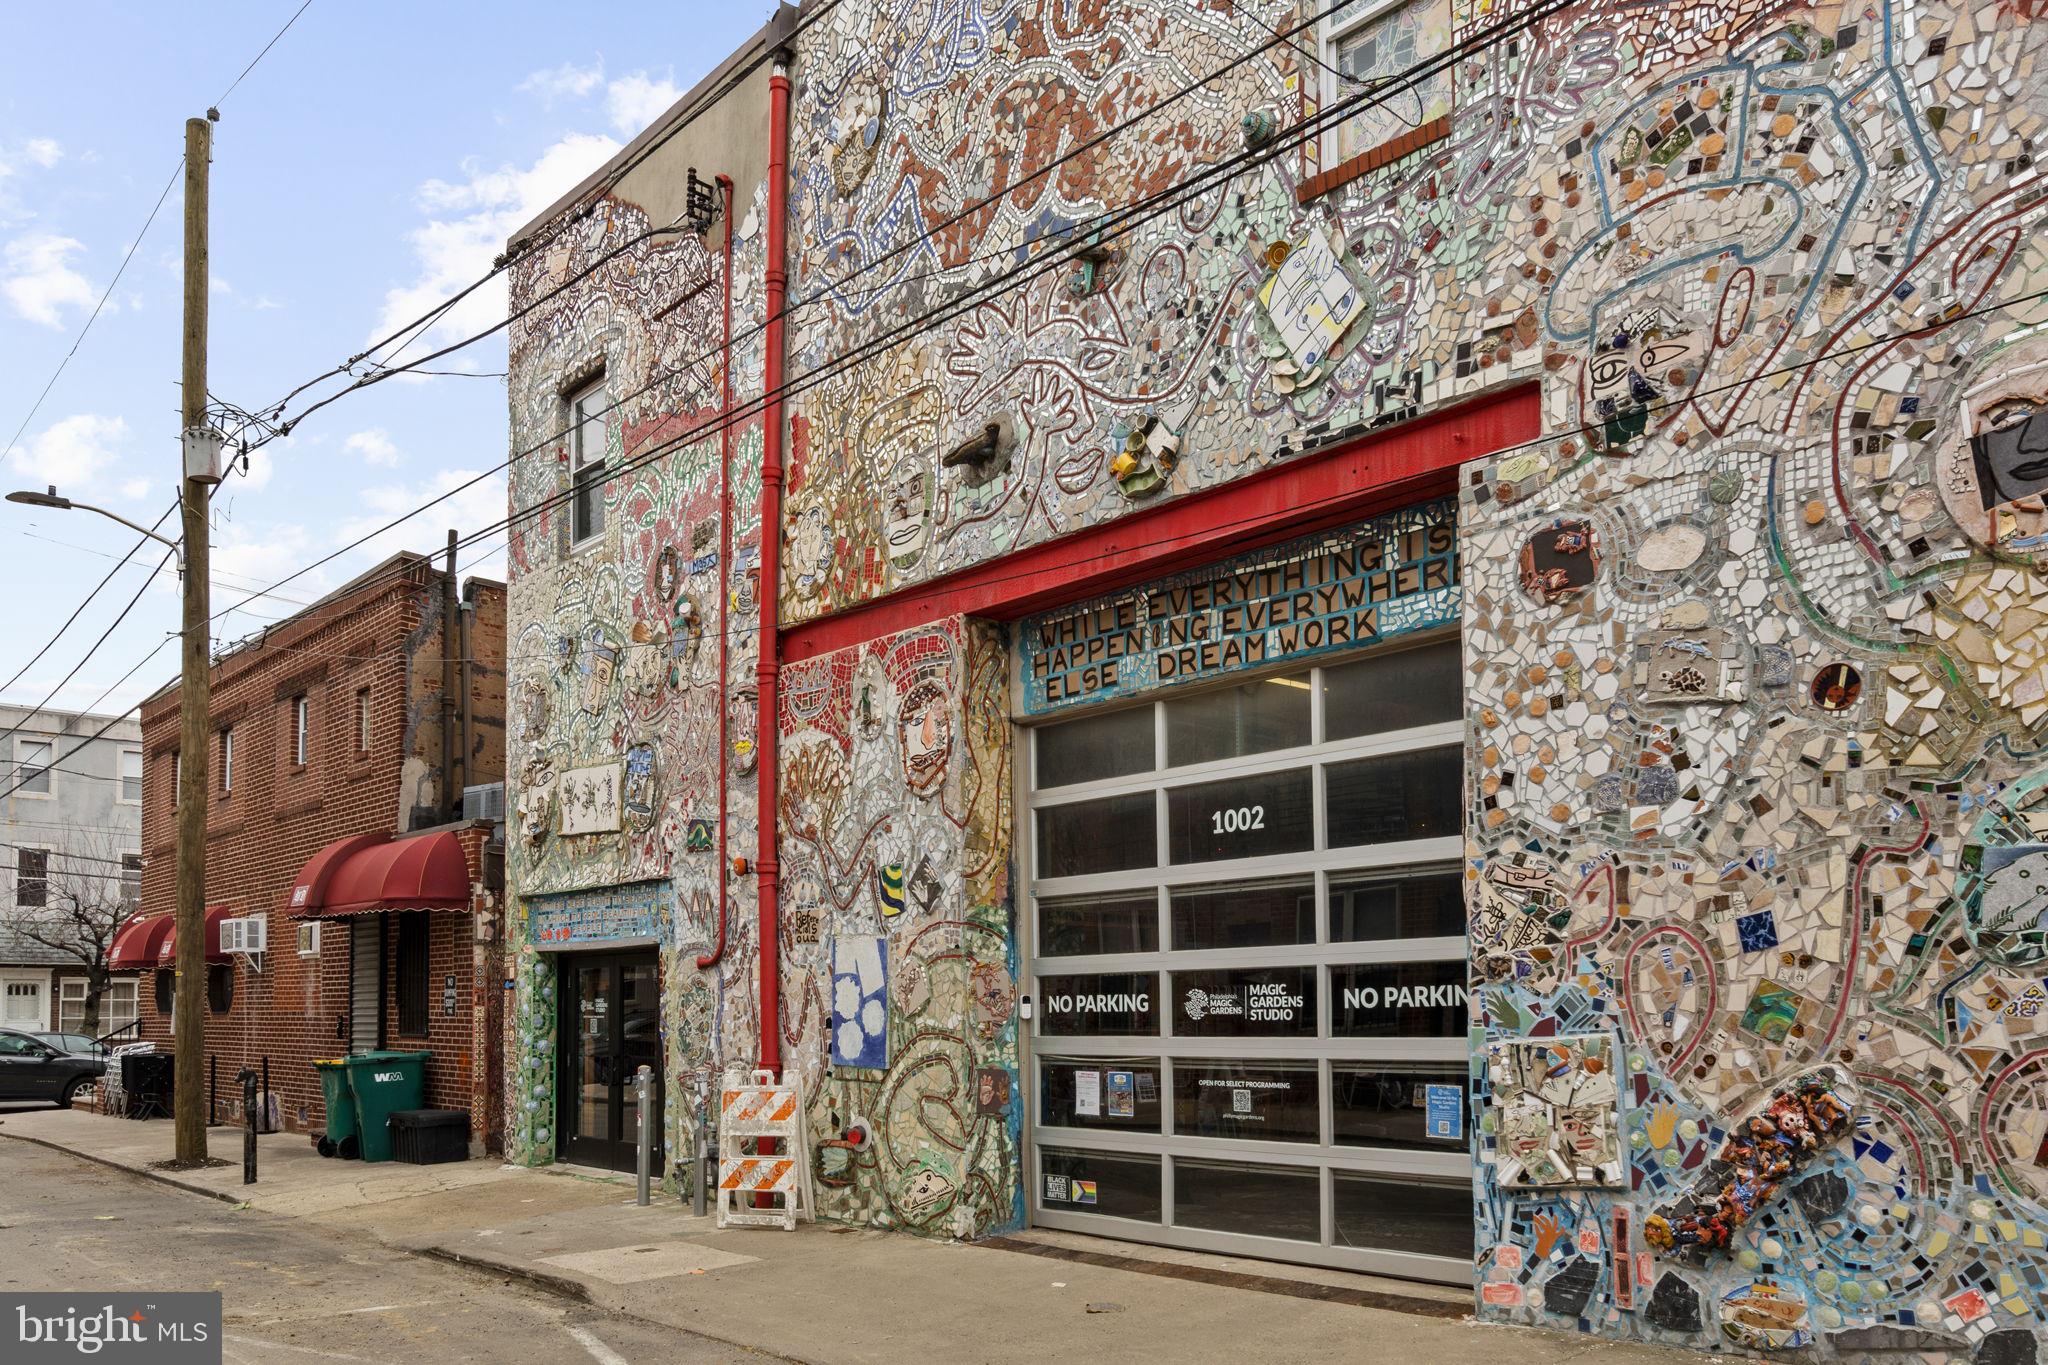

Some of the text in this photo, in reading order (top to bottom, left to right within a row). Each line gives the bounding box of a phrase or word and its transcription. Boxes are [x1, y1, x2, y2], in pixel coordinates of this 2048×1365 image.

[1040, 524, 1453, 649] WHILE EVERYTHING IS
[1046, 608, 1378, 702] ELSE DREAM WORK
[1212, 805, 1265, 834] 1002
[1249, 983, 1287, 996] MAGIC
[1048, 993, 1149, 1013] NO PARKING
[1209, 999, 1233, 1007] MAGIC
[1249, 995, 1304, 1008] GARDENS
[1343, 984, 1469, 1009] NO PARKIN
[1210, 1006, 1243, 1015] GARDENS
[1250, 1008, 1293, 1021] STUDIO
[374, 1071, 404, 1083] WM
[1198, 1079, 1214, 1087] OPEN
[1226, 1080, 1246, 1088] SELECT
[1245, 1081, 1291, 1089] PROGRAMMING
[1047, 1176, 1066, 1184] BLACK
[1047, 1182, 1067, 1193] LIVES
[1047, 1191, 1067, 1200] MATTER
